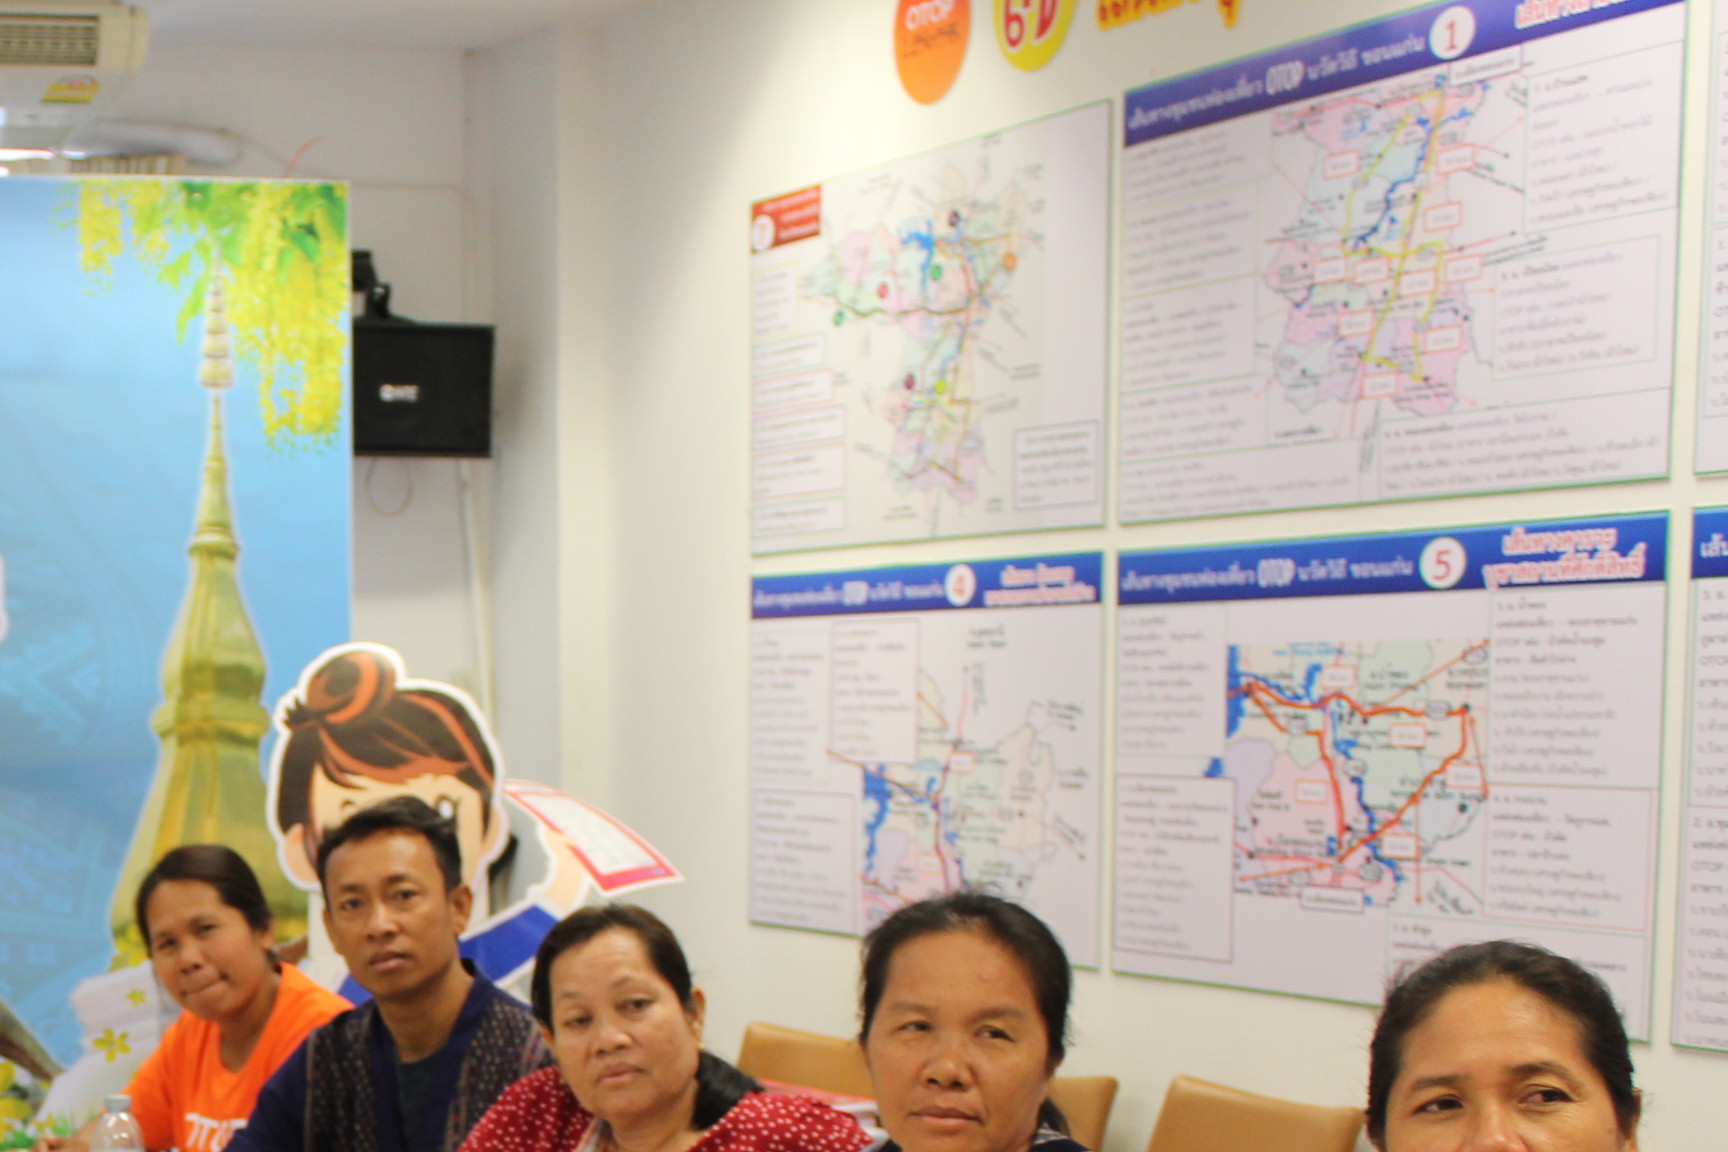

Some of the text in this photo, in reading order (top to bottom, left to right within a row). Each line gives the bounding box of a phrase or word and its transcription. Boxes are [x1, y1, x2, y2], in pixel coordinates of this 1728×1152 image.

[1445, 20, 1458, 51] 1
[1432, 549, 1451, 582] 5
[954, 574, 966, 598] 4
